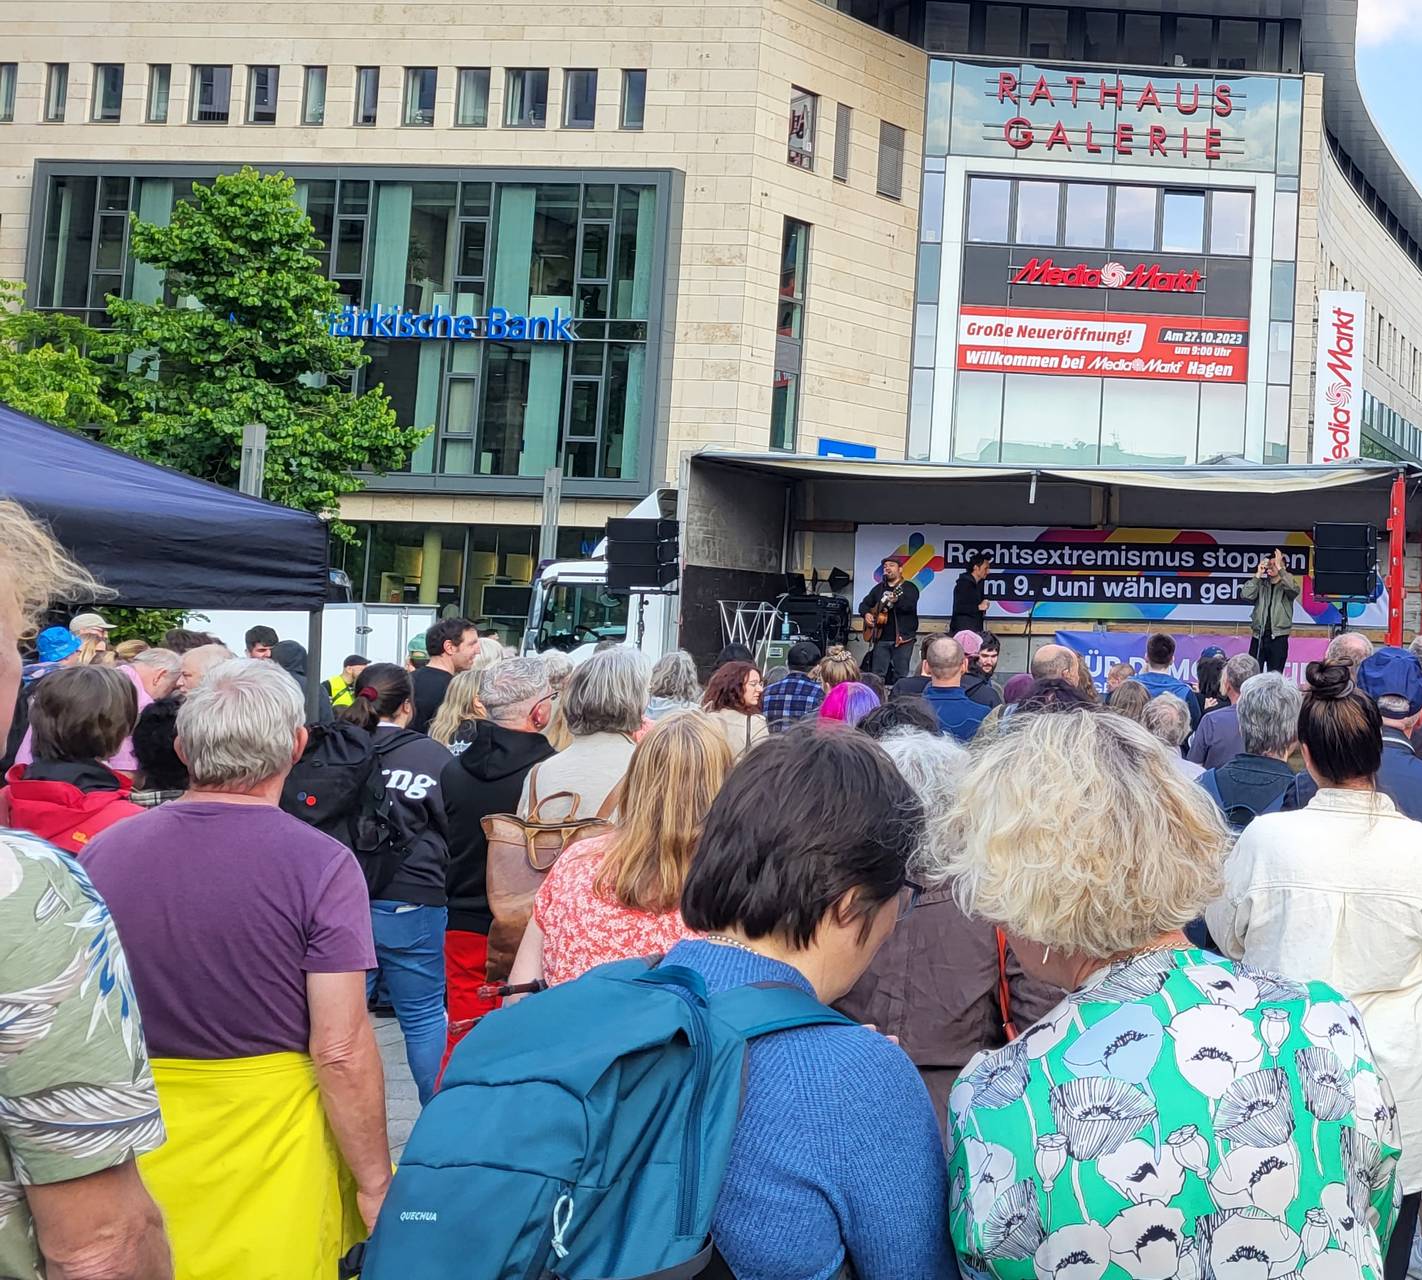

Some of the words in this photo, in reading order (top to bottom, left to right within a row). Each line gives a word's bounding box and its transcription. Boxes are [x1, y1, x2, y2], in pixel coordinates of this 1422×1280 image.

[997, 72, 1232, 117] RATHAUS
[1004, 117, 1221, 160] GALERIE
[328, 303, 475, 339] ärkische
[486, 307, 579, 341] Bank
[966, 322, 1013, 338] Große
[1016, 324, 1132, 345] Neueröffnung!
[1163, 330, 1183, 342] Am
[1184, 331, 1243, 345] 27.10.2023
[965, 351, 1060, 369] Willkommen
[1061, 355, 1085, 370] bei
[1186, 362, 1233, 377] Hagen
[1174, 347, 1190, 356] um
[1191, 346, 1212, 356] 9:00
[1213, 347, 1232, 357] Uhr
[1323, 405, 1350, 462] edia
[983, 577, 1006, 596] m
[1013, 575, 1034, 596] 9.
[1042, 576, 1095, 597] Juni
[1103, 576, 1193, 599] wählen
[400, 1211, 437, 1222] QUECHUA
